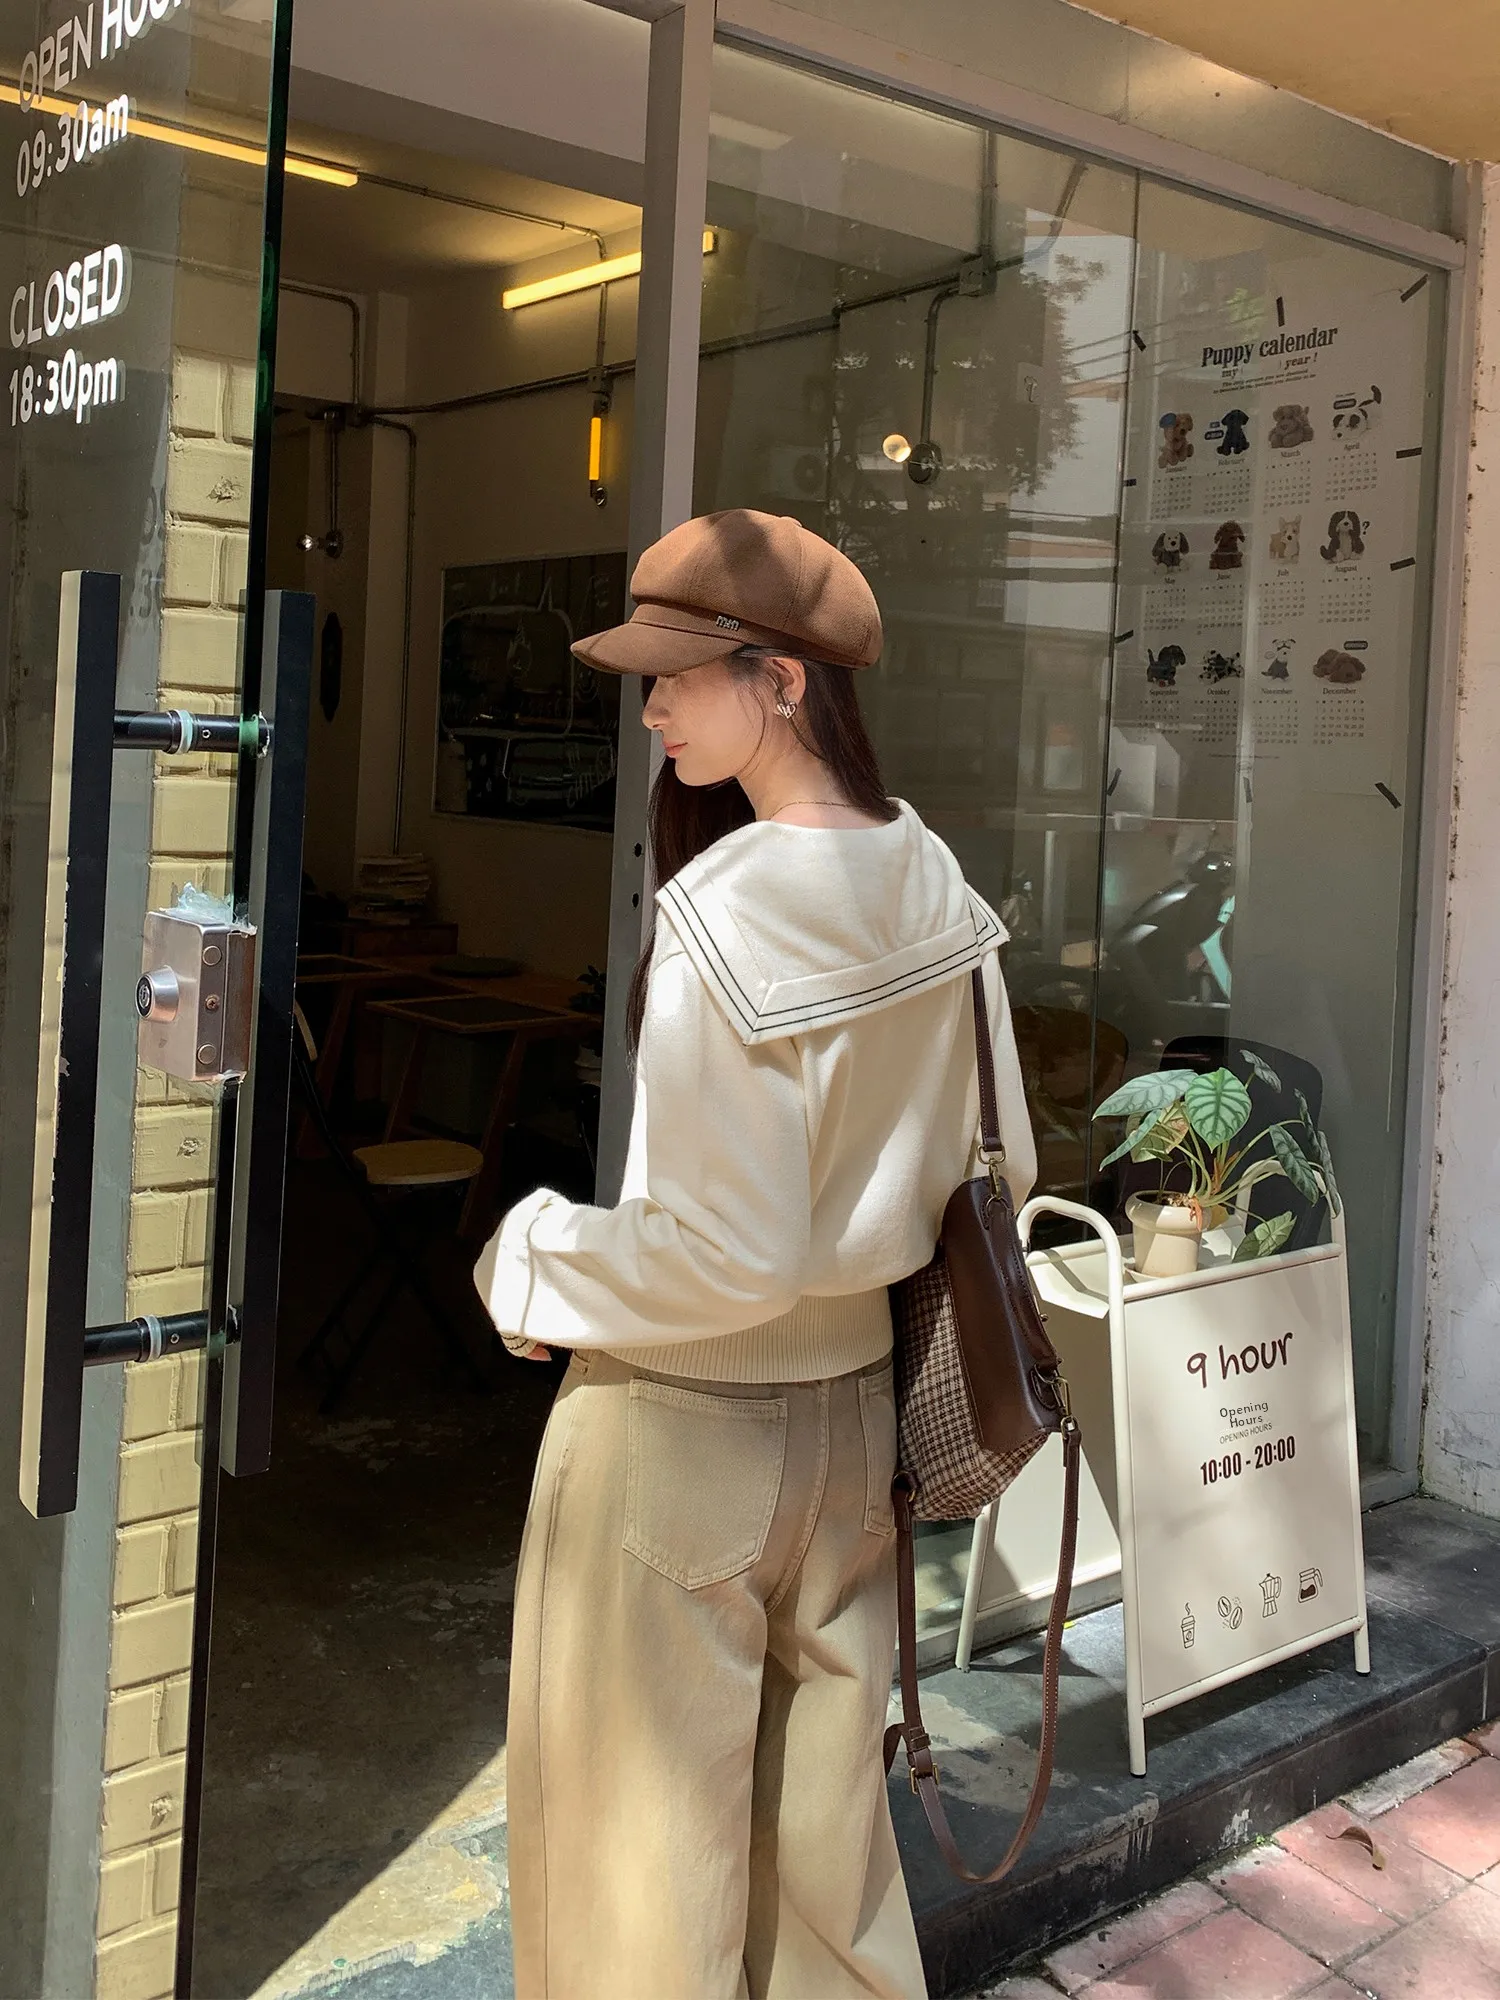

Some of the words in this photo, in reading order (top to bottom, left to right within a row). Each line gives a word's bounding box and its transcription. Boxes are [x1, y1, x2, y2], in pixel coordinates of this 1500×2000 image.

[20, 3, 95, 113] OPEN
[17, 94, 129, 197] 09:30am
[9, 243, 123, 348] CLOSED
[1201, 342, 1254, 369] Puppy
[1259, 327, 1338, 358] calendar
[1284, 355, 1311, 370] year
[9, 348, 117, 426] 18:30pm
[1322, 687, 1357, 695] December
[1219, 1332, 1293, 1380] hour
[1219, 1402, 1269, 1419] Opening
[1230, 1415, 1263, 1428] Hours
[1219, 1429, 1250, 1445] OPENING
[1250, 1422, 1273, 1436] HOURS
[1200, 1452, 1242, 1485] 10:00
[1254, 1436, 1296, 1469] 20:00
